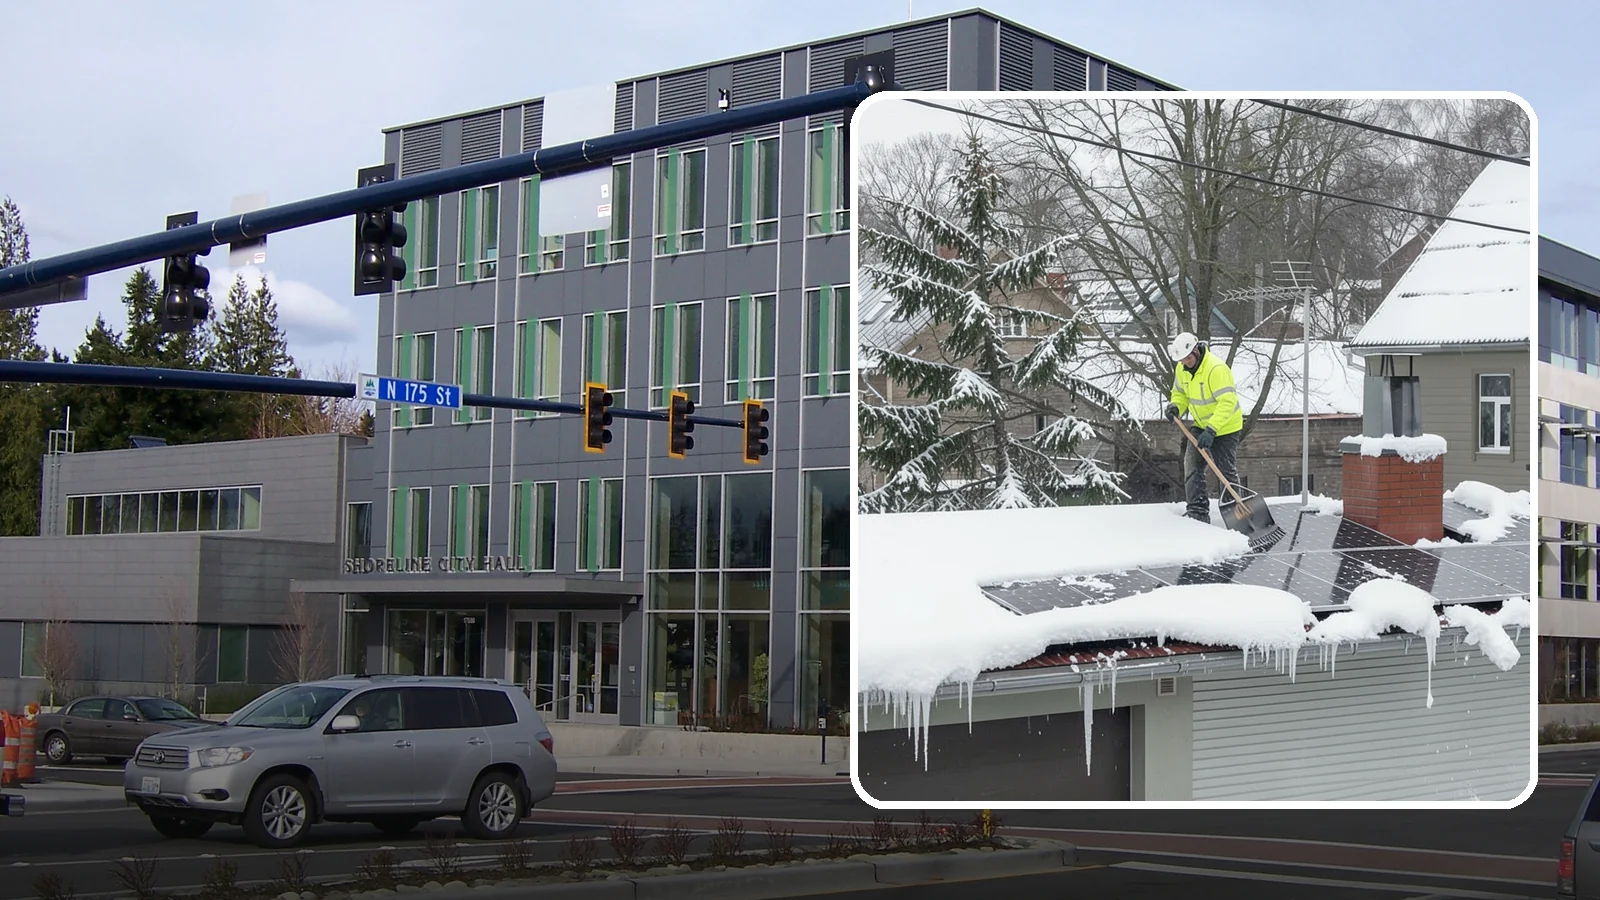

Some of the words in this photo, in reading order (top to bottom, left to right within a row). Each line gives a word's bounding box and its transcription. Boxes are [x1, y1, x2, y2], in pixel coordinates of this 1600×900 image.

[387, 380, 396, 400] N
[405, 382, 428, 403] 175
[436, 386, 451, 406] St
[344, 556, 432, 574] SHORELINE
[438, 555, 476, 573] CITY
[483, 555, 525, 572] HALL
